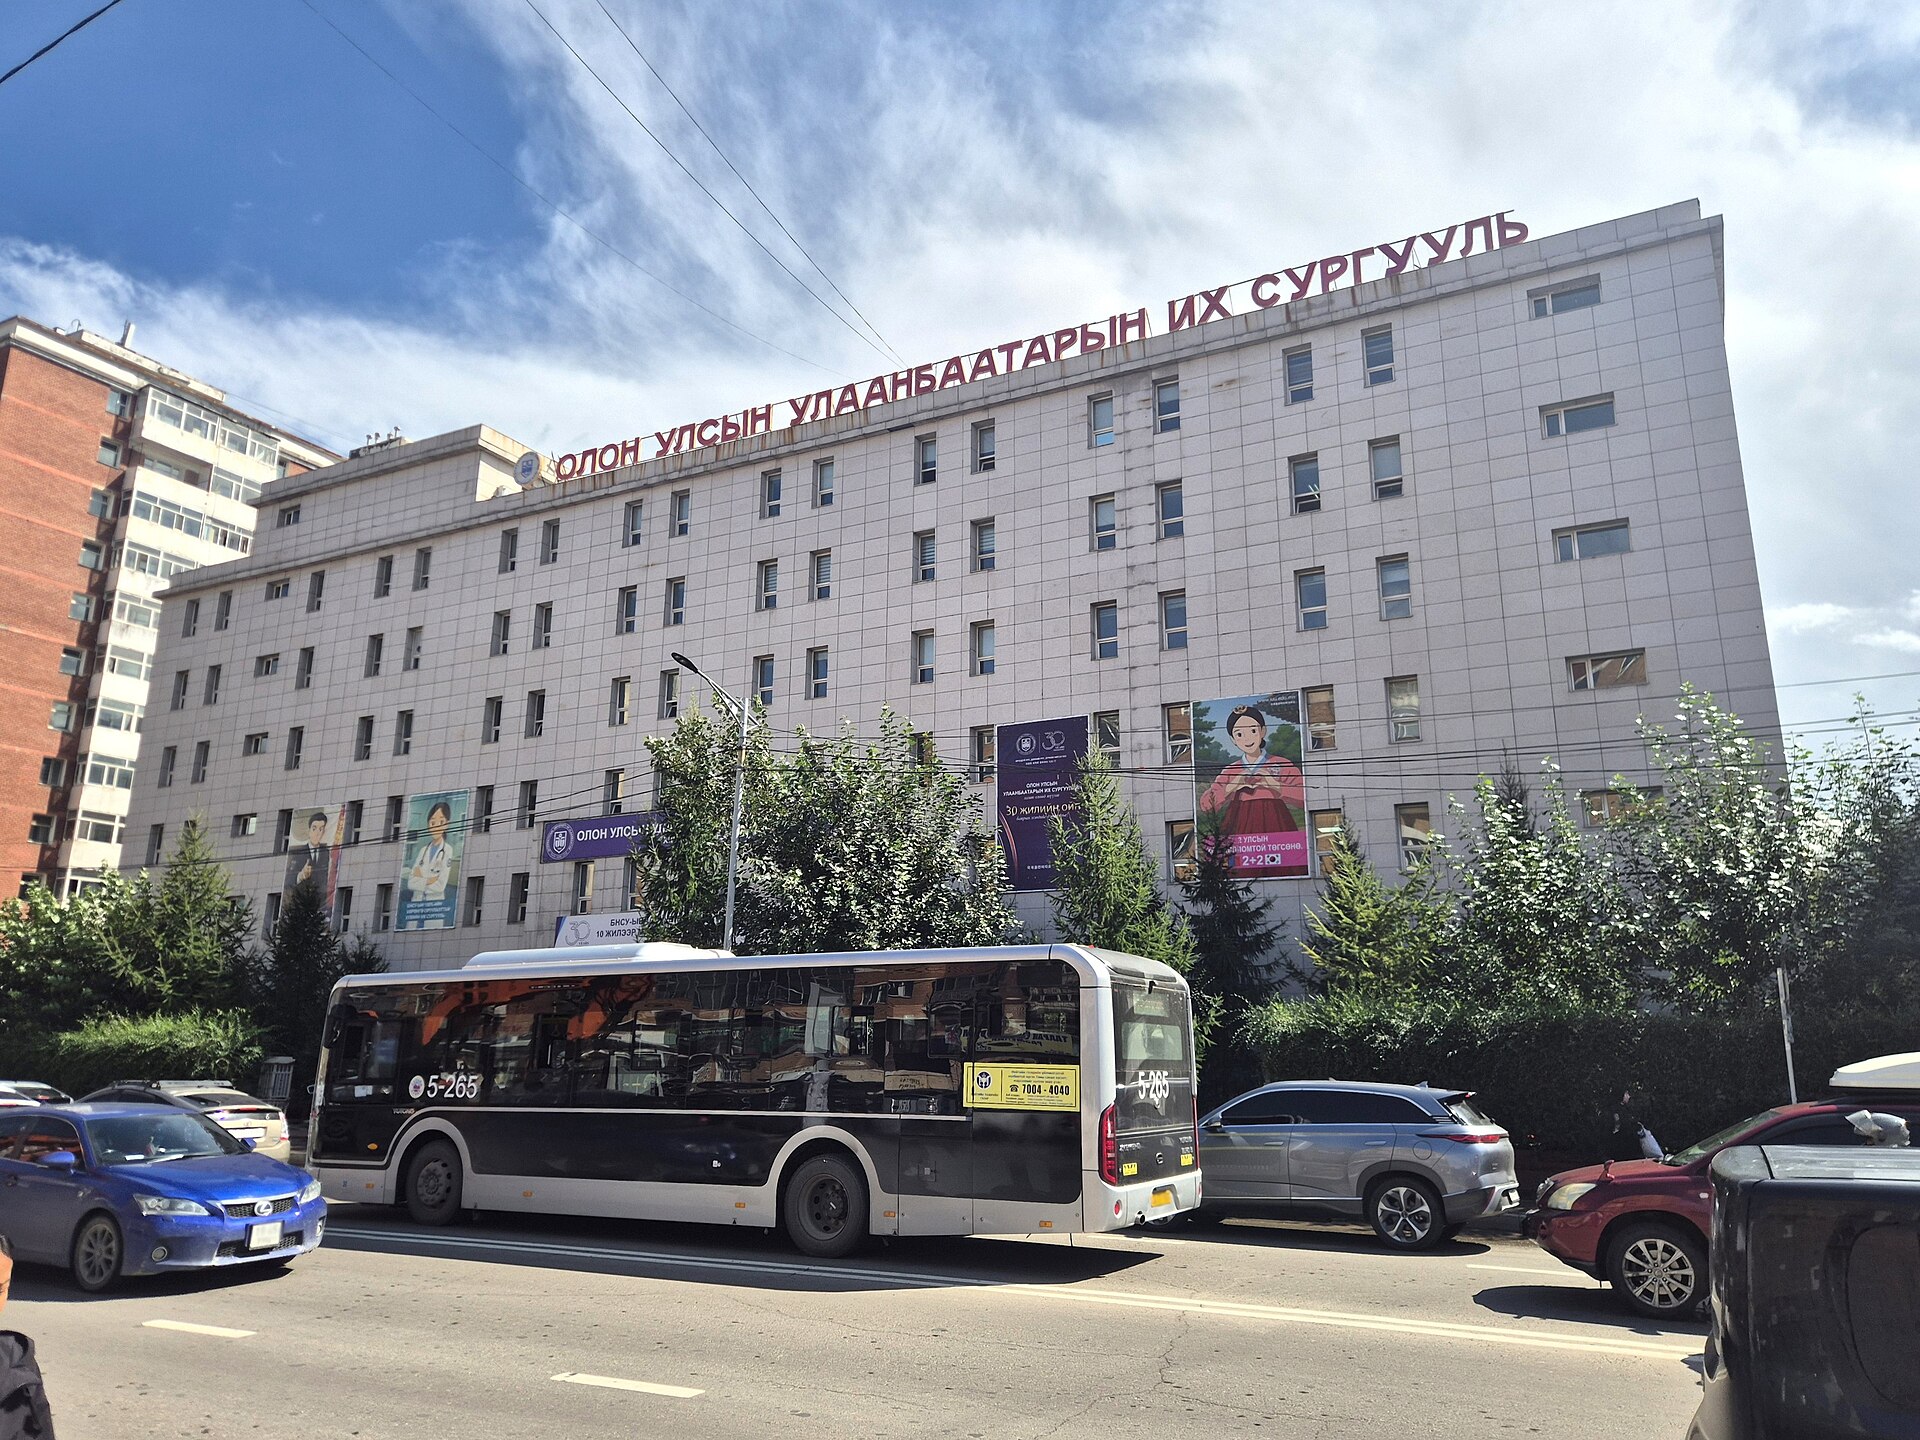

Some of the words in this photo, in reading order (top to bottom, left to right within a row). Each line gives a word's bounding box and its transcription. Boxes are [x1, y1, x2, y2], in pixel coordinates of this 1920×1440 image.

[555, 437, 641, 481] ОЛОН
[655, 403, 773, 458] УЛСЫН
[788, 308, 1147, 425] УЛААНБААТАРЫН
[1168, 285, 1232, 332] ИХ
[1251, 212, 1529, 309] СУРГУУЛЬ
[1006, 804, 1018, 816] 30
[1020, 802, 1059, 815] ЖИЛИЙН
[577, 828, 607, 841] ОЛОН
[1243, 835, 1268, 843] УЛСЫН
[1242, 855, 1264, 866] 2+2
[596, 930, 604, 938] 10
[605, 929, 636, 938] ЖИЛЭЭР
[426, 1074, 479, 1098] 5-265
[1022, 1084, 1042, 1094] 7004
[1048, 1085, 1070, 1096] 4040
[1138, 1071, 1169, 1099] 5-265
